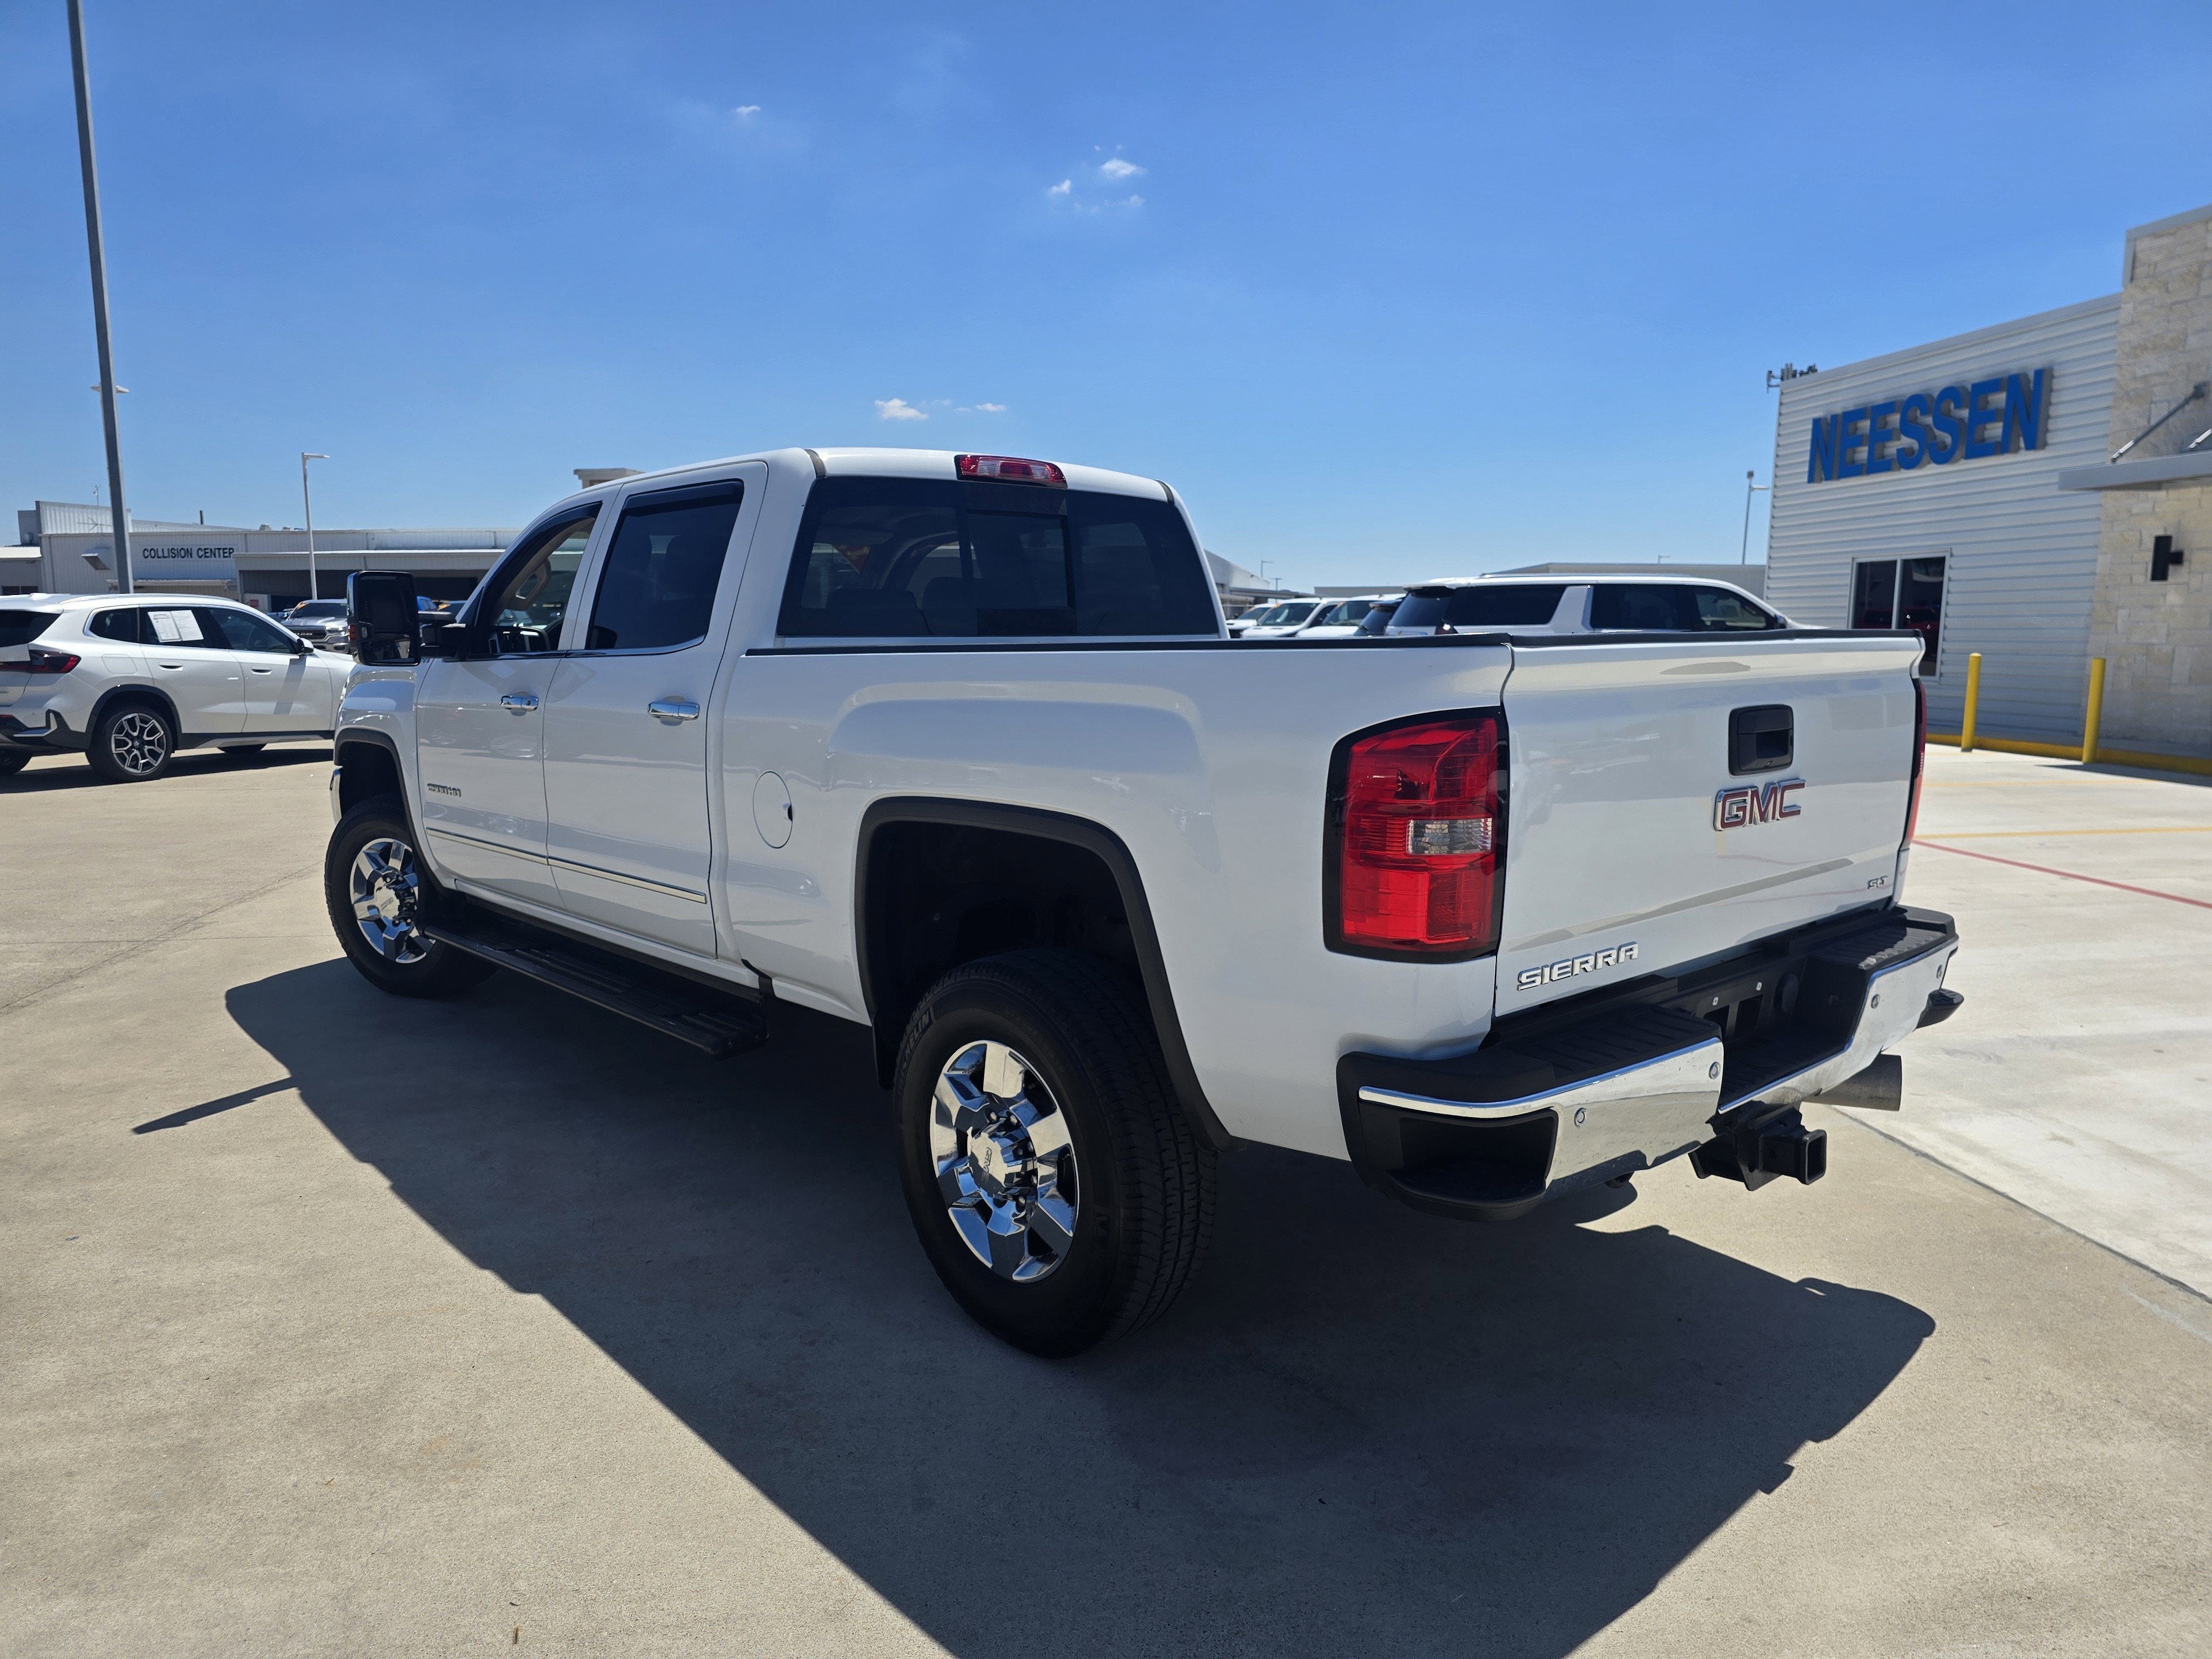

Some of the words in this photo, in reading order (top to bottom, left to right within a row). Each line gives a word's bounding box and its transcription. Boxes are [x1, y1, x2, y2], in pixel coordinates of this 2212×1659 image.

[1807, 368, 2053, 483] NEESSEN
[142, 547, 193, 559] COLLISION
[197, 547, 234, 559] CENTER
[1713, 778, 1806, 831] GMC
[1517, 941, 1639, 992] SIERRA
